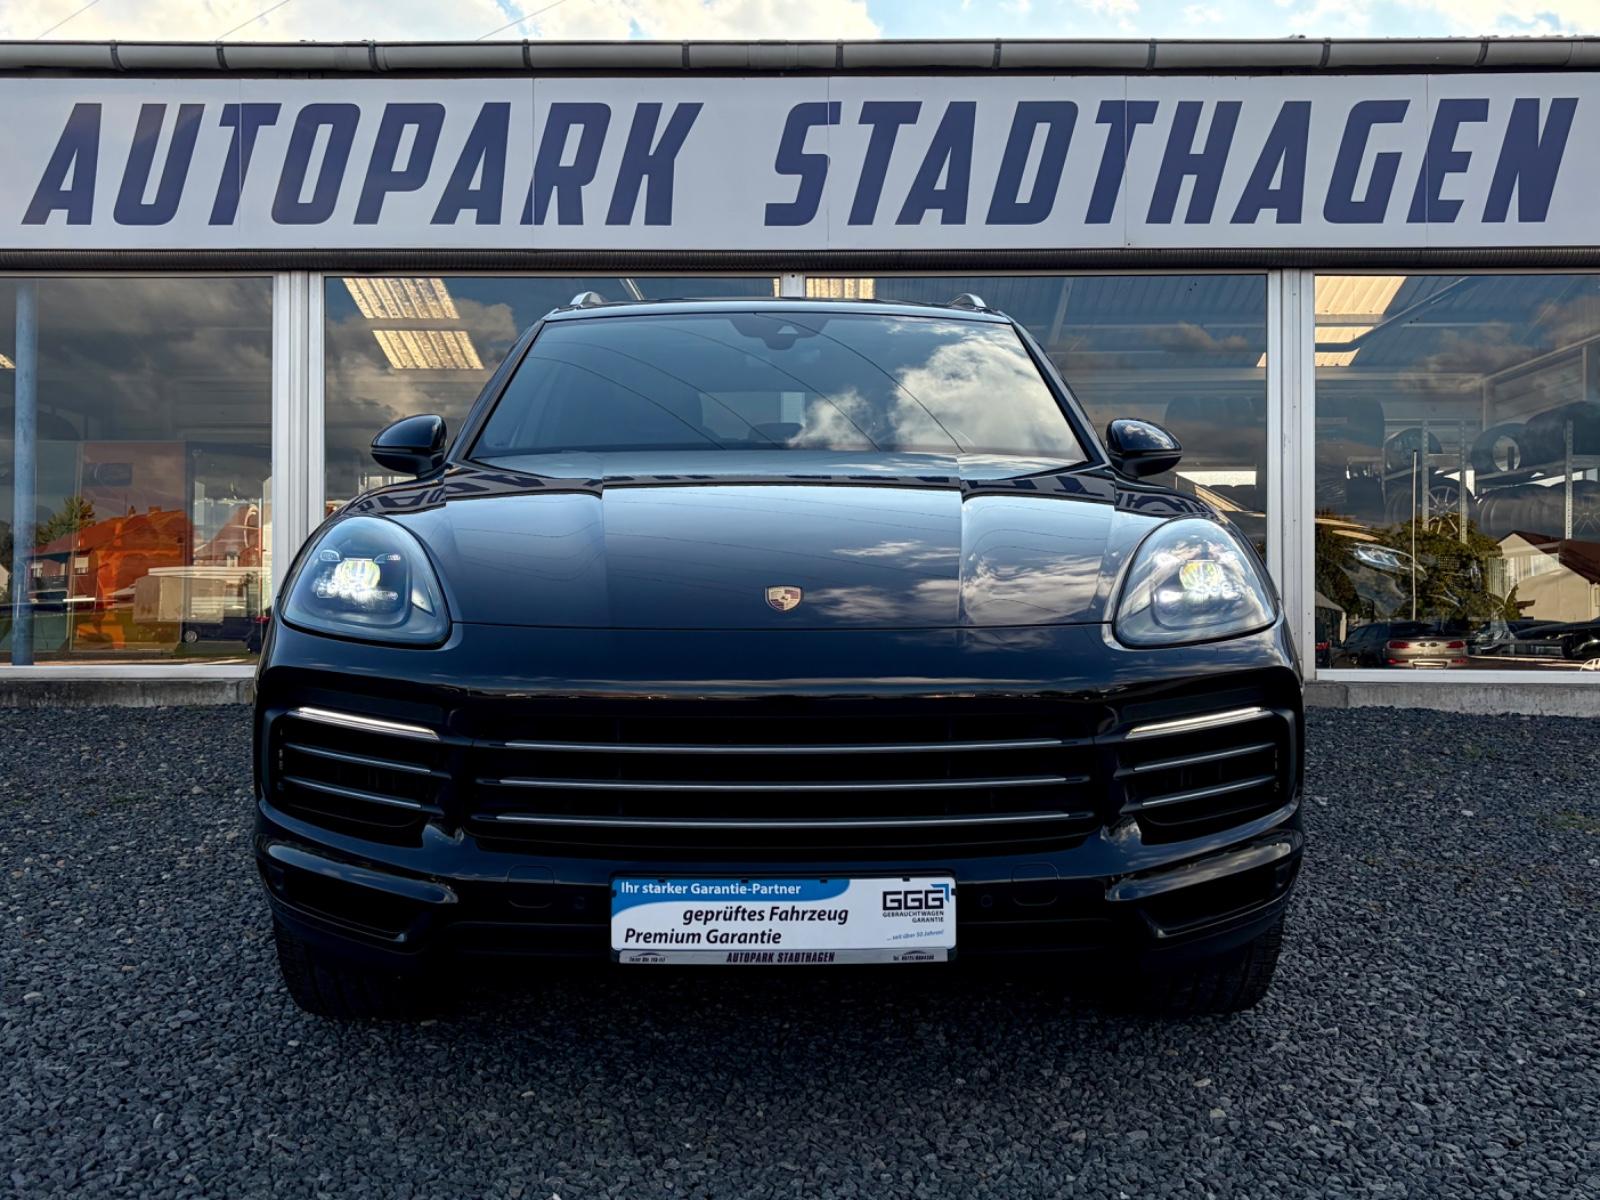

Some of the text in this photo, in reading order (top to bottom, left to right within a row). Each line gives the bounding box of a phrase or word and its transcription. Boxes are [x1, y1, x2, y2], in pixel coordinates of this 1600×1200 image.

[20, 97, 1580, 227] AUTOPARK STADTHAGEN
[621, 882, 801, 895] Ihr starker Garantie-Partner
[882, 889, 944, 911] GGG
[682, 905, 849, 925] geprüftes Fahrzeug
[624, 928, 782, 944] Premium Garantie
[726, 952, 835, 963] AUTOPARK STADTHAGEN
